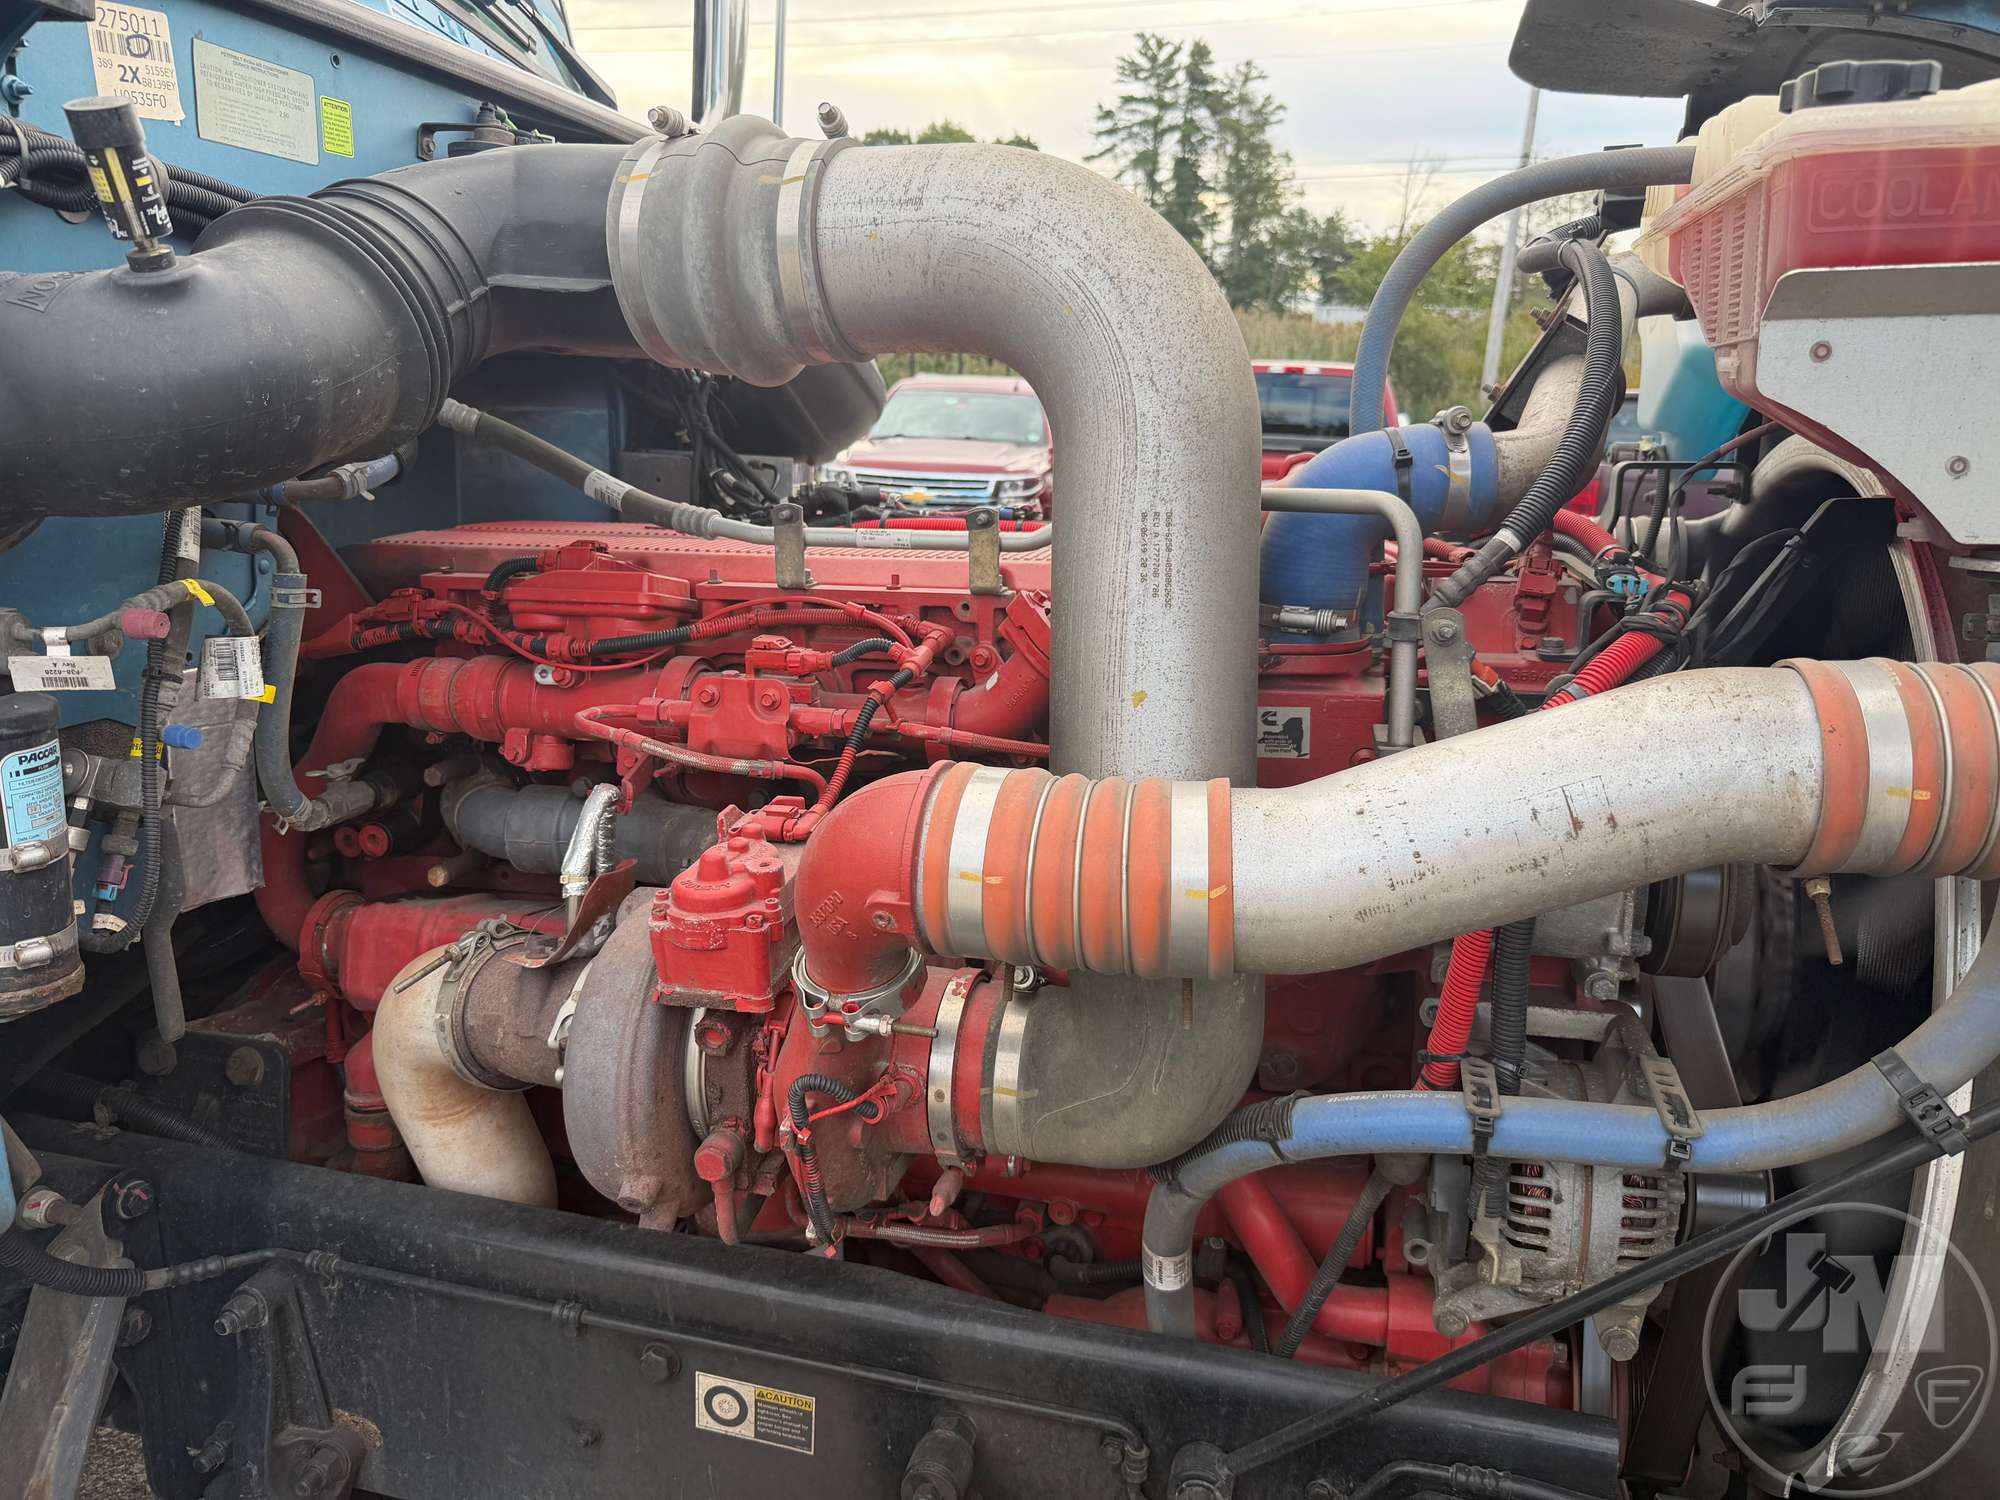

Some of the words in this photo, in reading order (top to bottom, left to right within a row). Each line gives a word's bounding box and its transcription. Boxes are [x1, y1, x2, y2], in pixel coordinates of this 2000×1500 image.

[96, 7, 160, 37] 275011
[97, 57, 113, 69] 389
[117, 64, 142, 84] 2X
[766, 1392, 812, 1408] CAUTION
